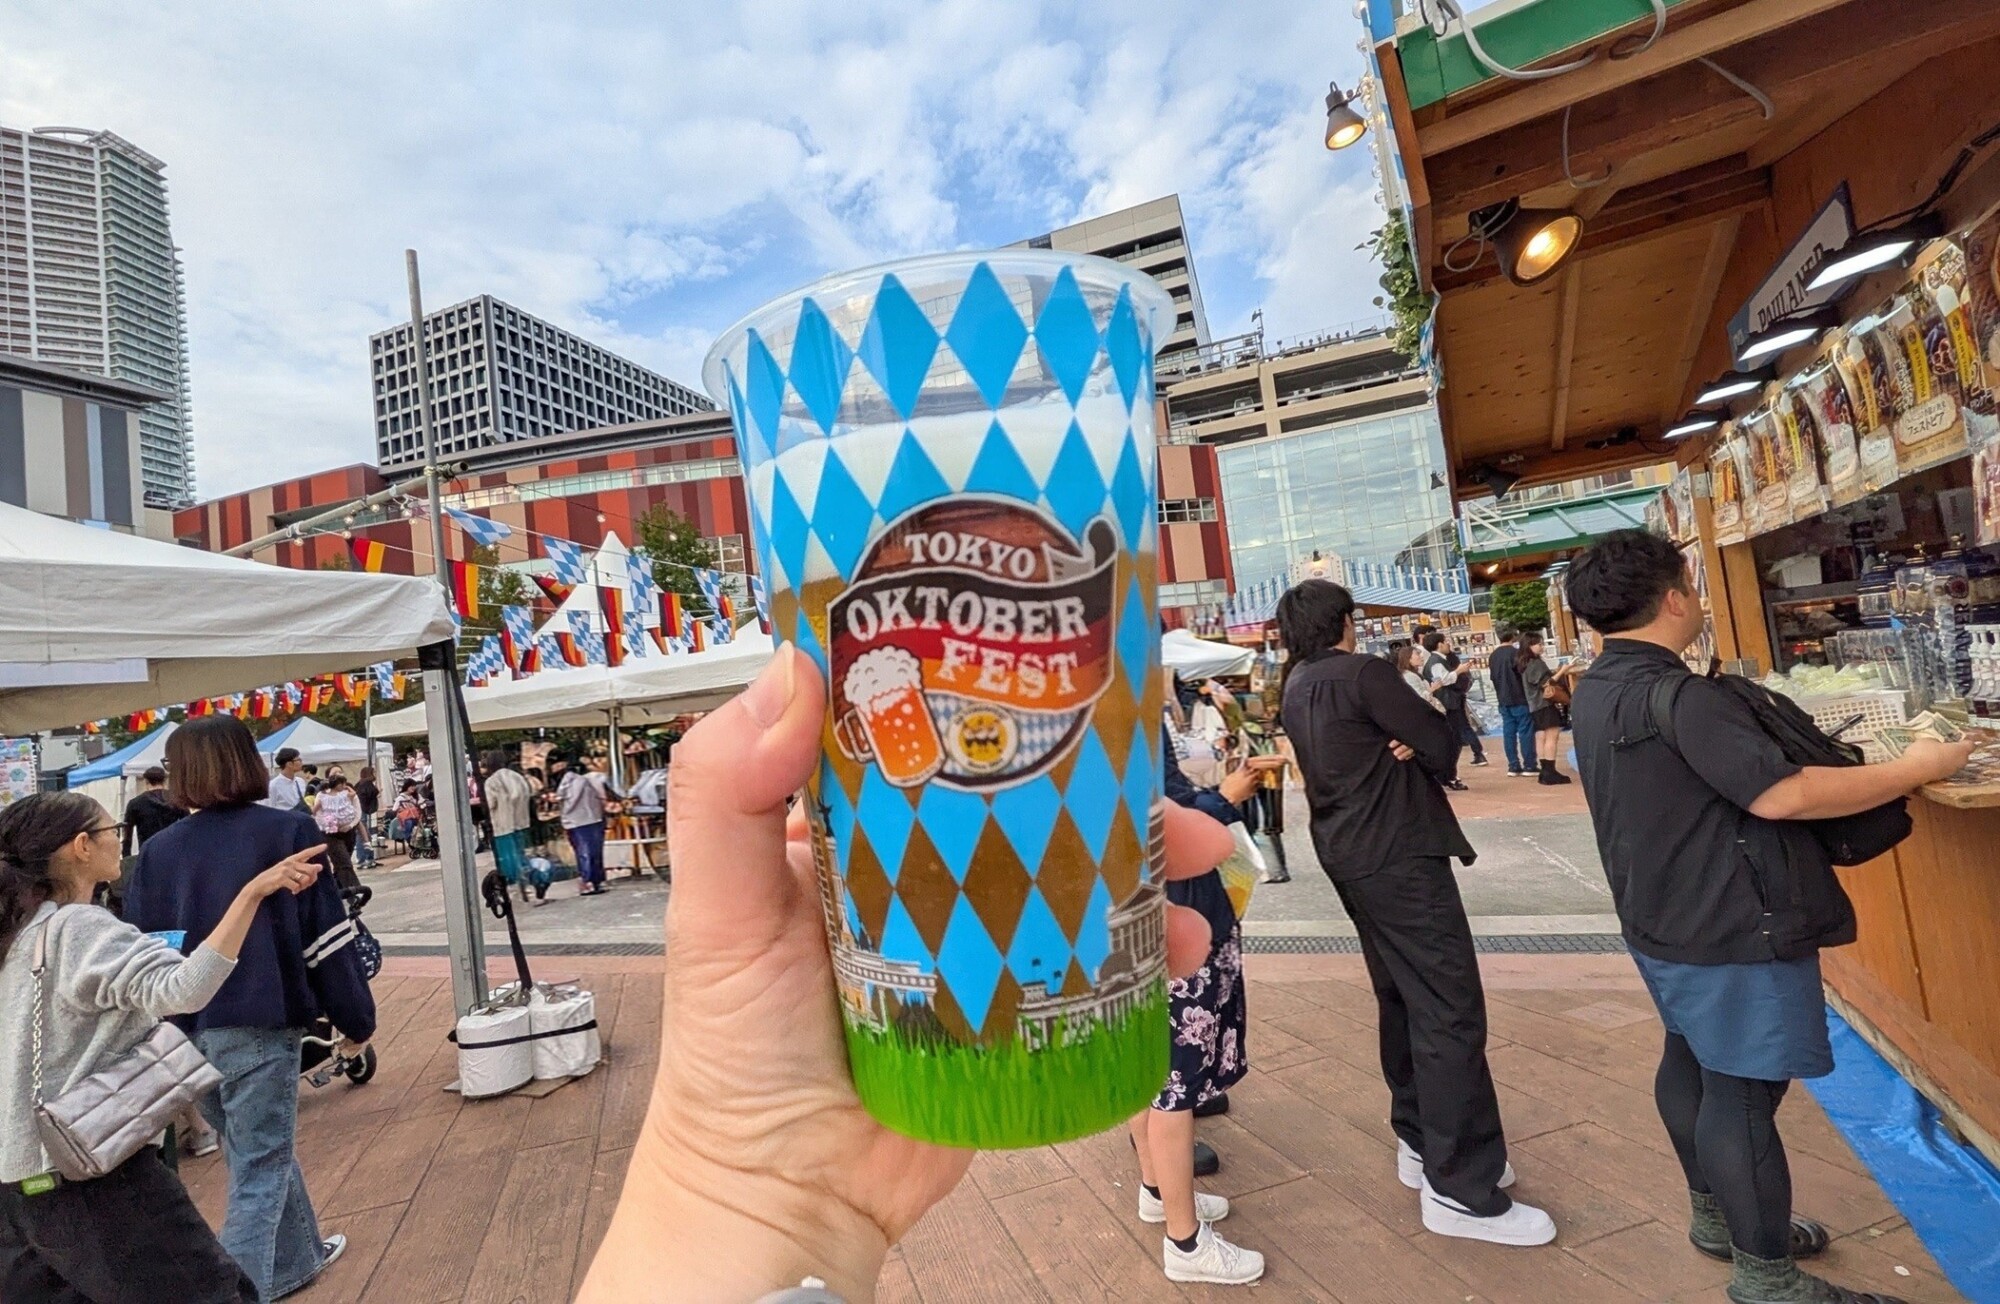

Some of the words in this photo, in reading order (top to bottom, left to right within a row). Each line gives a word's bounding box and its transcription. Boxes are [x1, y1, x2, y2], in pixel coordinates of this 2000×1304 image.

[905, 531, 1036, 579] TOKYO
[846, 585, 1090, 643] OKTOBER
[935, 636, 1078, 698] FEST
